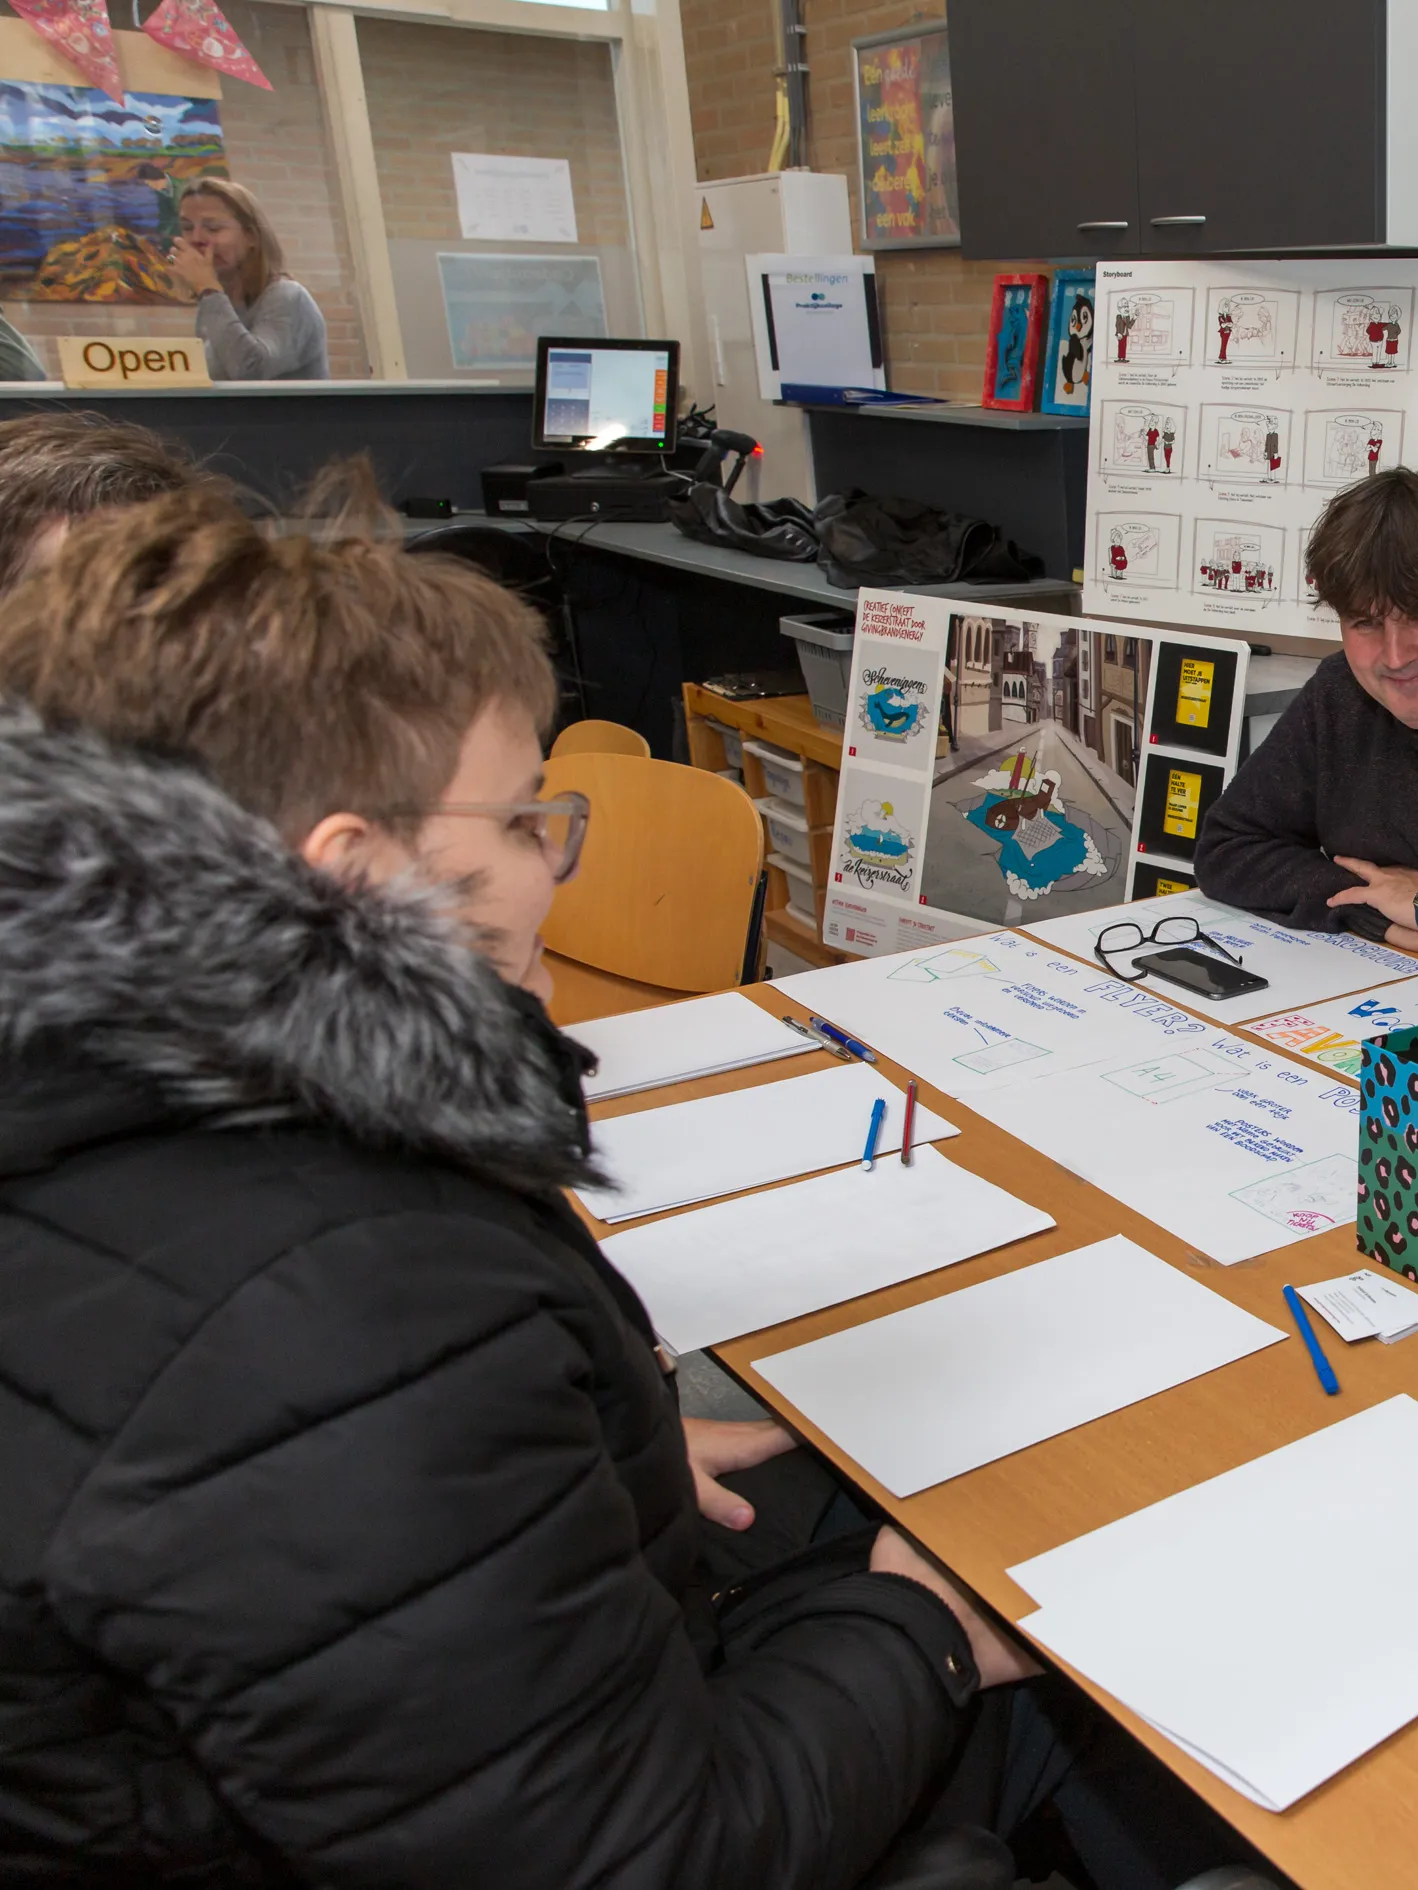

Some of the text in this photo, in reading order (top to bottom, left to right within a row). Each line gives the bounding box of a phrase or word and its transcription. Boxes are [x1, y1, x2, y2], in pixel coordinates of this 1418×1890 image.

[786, 273, 848, 286] Bestellingen
[1102, 271, 1133, 279] Storyboard
[83, 341, 191, 380] Open
[863, 600, 916, 617] CREATIEF CONCEPT
[862, 612, 927, 630] DE KEIZERSTRAAT DOOR
[1182, 675, 1211, 685] UITSTAPPEN
[989, 933, 1207, 1036] Wat is een FLYER?
[1211, 1037, 1251, 1060] Wat
[1254, 1060, 1272, 1071] is
[1276, 1070, 1309, 1087] een
